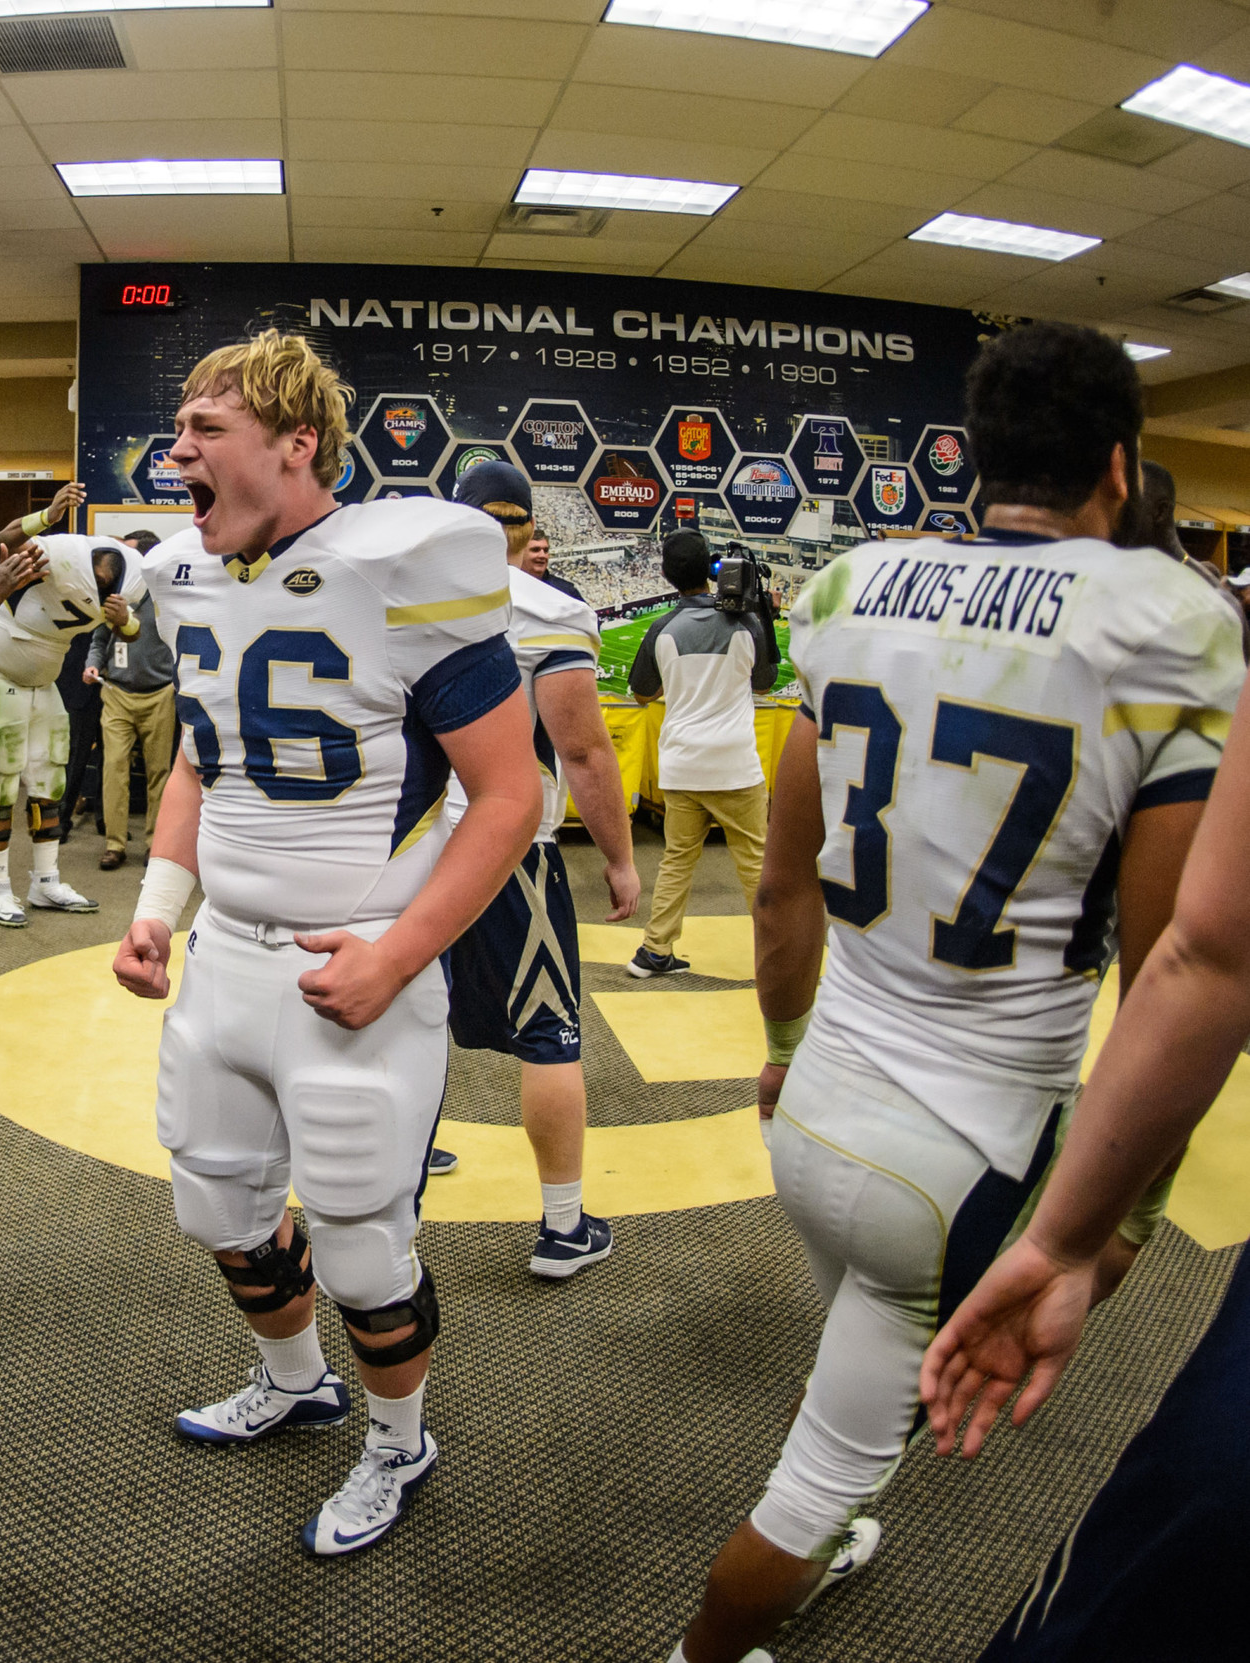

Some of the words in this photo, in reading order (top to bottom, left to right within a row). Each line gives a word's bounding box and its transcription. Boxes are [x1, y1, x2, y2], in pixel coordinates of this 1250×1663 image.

[121, 285, 171, 305] 0:00
[310, 298, 595, 336] NATIONAL
[613, 309, 915, 363] CHAMPIONS
[413, 342, 498, 363] 1917
[535, 347, 617, 370] 1928
[652, 354, 731, 377] 1952
[763, 362, 838, 386] 1990
[384, 419, 427, 430] CHAMPS
[522, 420, 585, 435] COTTON
[680, 426, 709, 439] GATOR
[392, 459, 419, 467] 2004
[817, 477, 840, 485] 1972
[874, 470, 903, 483] FedEx
[600, 485, 655, 501] EMERALD
[732, 482, 796, 499] HUMANITARIAN
[287, 572, 319, 586] ACC
[852, 557, 1079, 638] LANDS-DAVIS
[175, 621, 367, 807] 66
[816, 677, 1082, 976] 37
